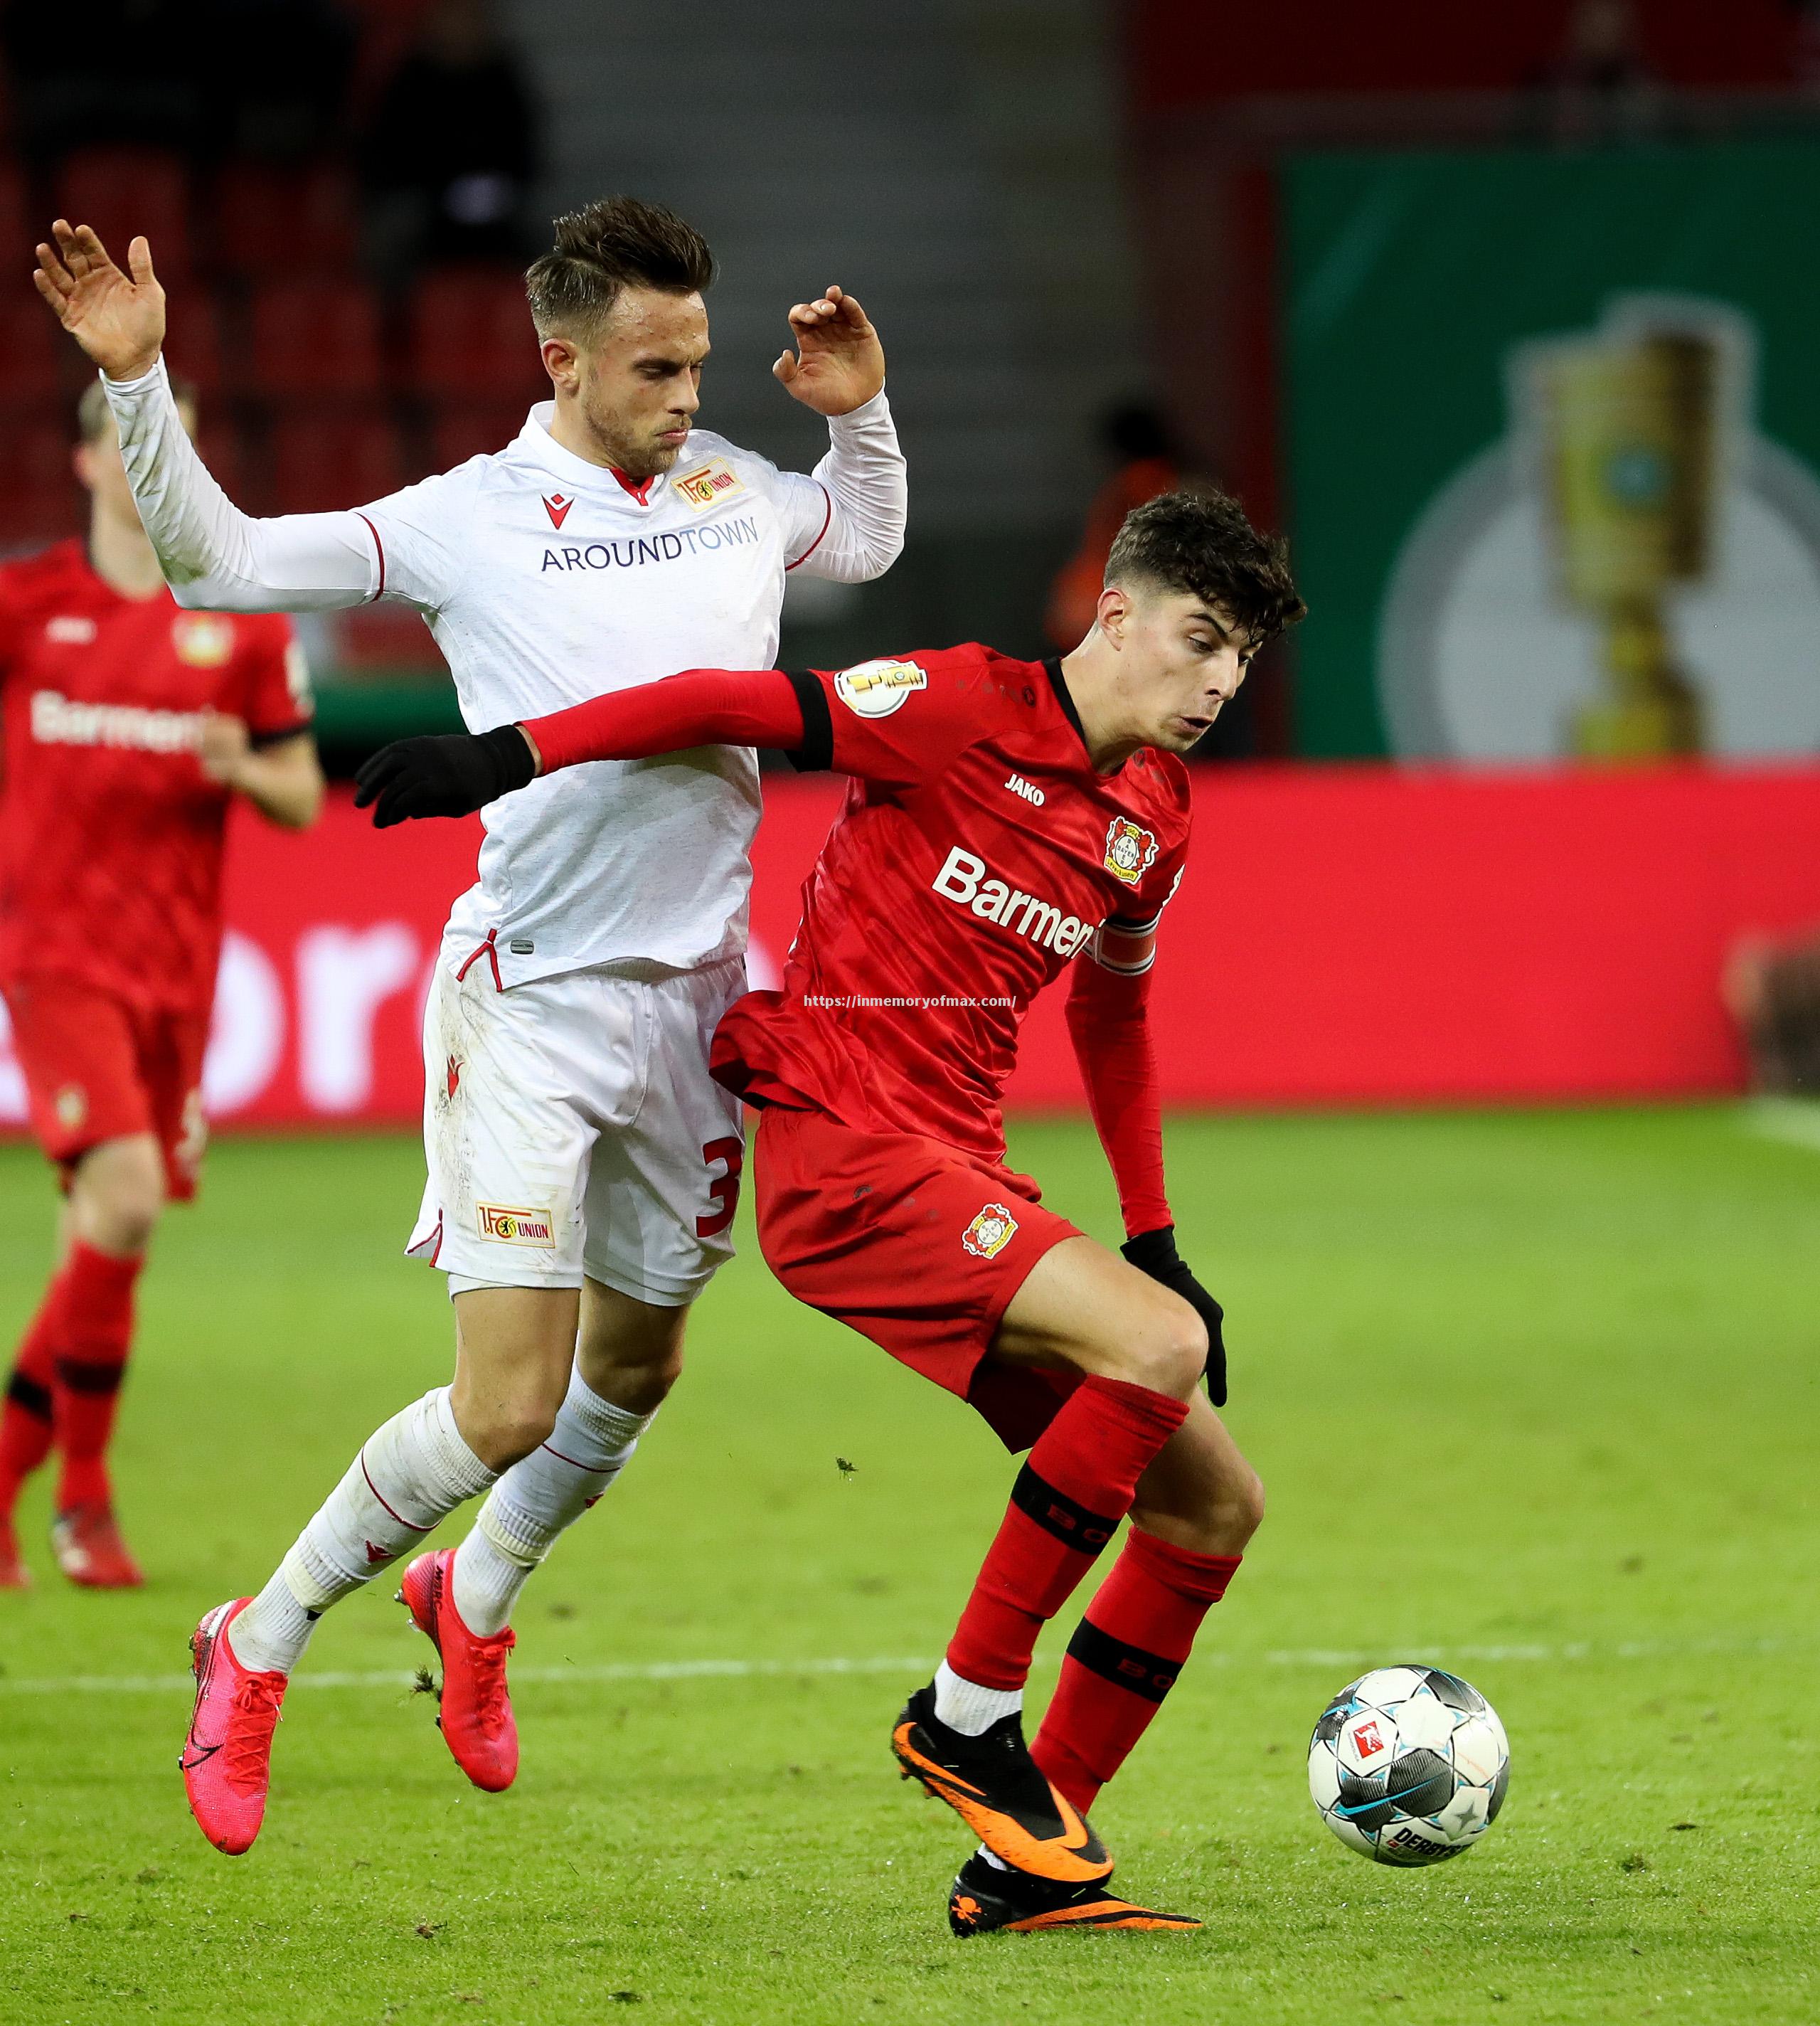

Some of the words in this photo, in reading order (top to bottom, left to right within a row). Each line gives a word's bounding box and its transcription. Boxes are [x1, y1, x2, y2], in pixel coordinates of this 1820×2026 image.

[708, 472, 734, 492] UNION
[541, 516, 758, 571] AROUNDTOWN
[1004, 773, 1045, 806] JAKO
[1117, 845, 1134, 858] BAYER
[1120, 839, 1132, 866] BAYER
[932, 845, 1094, 959] Barmen
[517, 1222, 549, 1239] UNION
